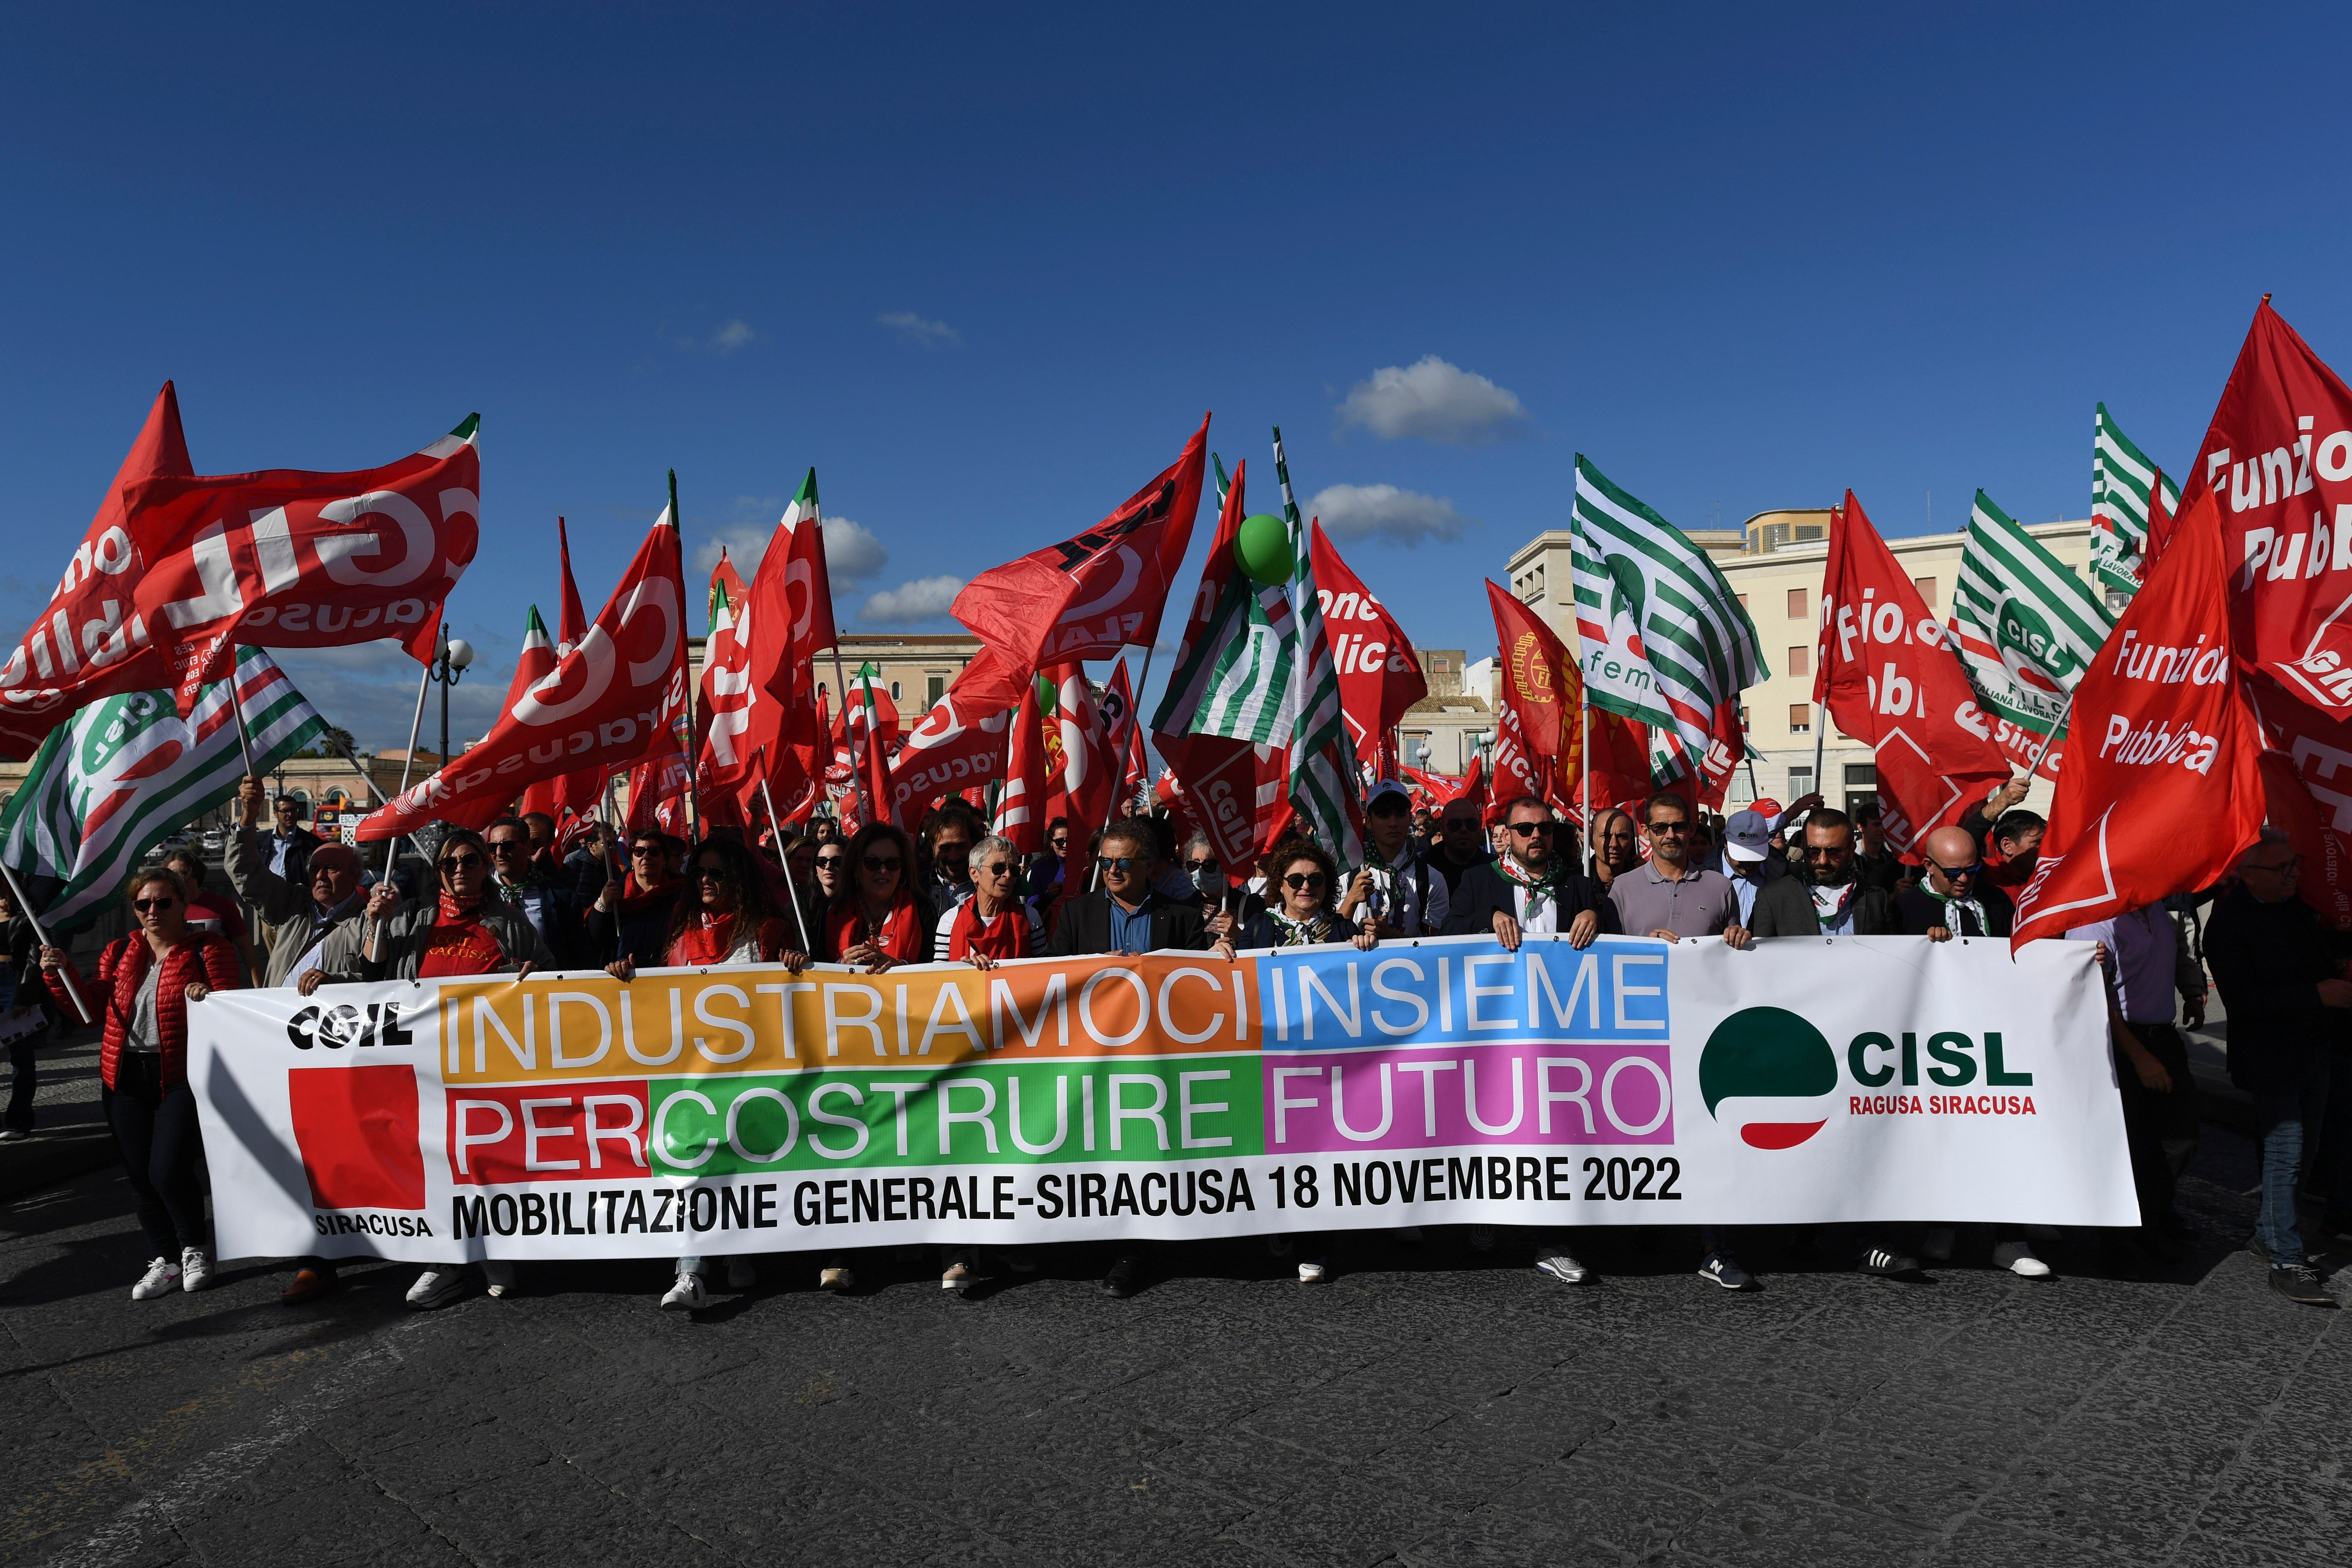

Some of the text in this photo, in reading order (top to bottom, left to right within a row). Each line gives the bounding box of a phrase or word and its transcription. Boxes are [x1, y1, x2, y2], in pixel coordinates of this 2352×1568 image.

[2007, 618, 2061, 668] CISL
[2099, 713, 2219, 776] Pubblica
[1209, 779, 1253, 853] CGIL
[436, 934, 472, 947] CGIL
[287, 1002, 413, 1050] CGIL
[446, 953, 1666, 1074] INDUSTRIAMOCI INSIEME
[1847, 1031, 2033, 1087] CISL
[453, 1056, 1672, 1176] PER COSTRUIRE FUTURO
[1849, 1095, 2036, 1116] RAGUSA SIRACUSA
[316, 1213, 433, 1238] SIRACUSA
[454, 1156, 1682, 1240] MOBILITAZIONE GENERALE-SIRACUSA 18 NOVEMBRE 2022
